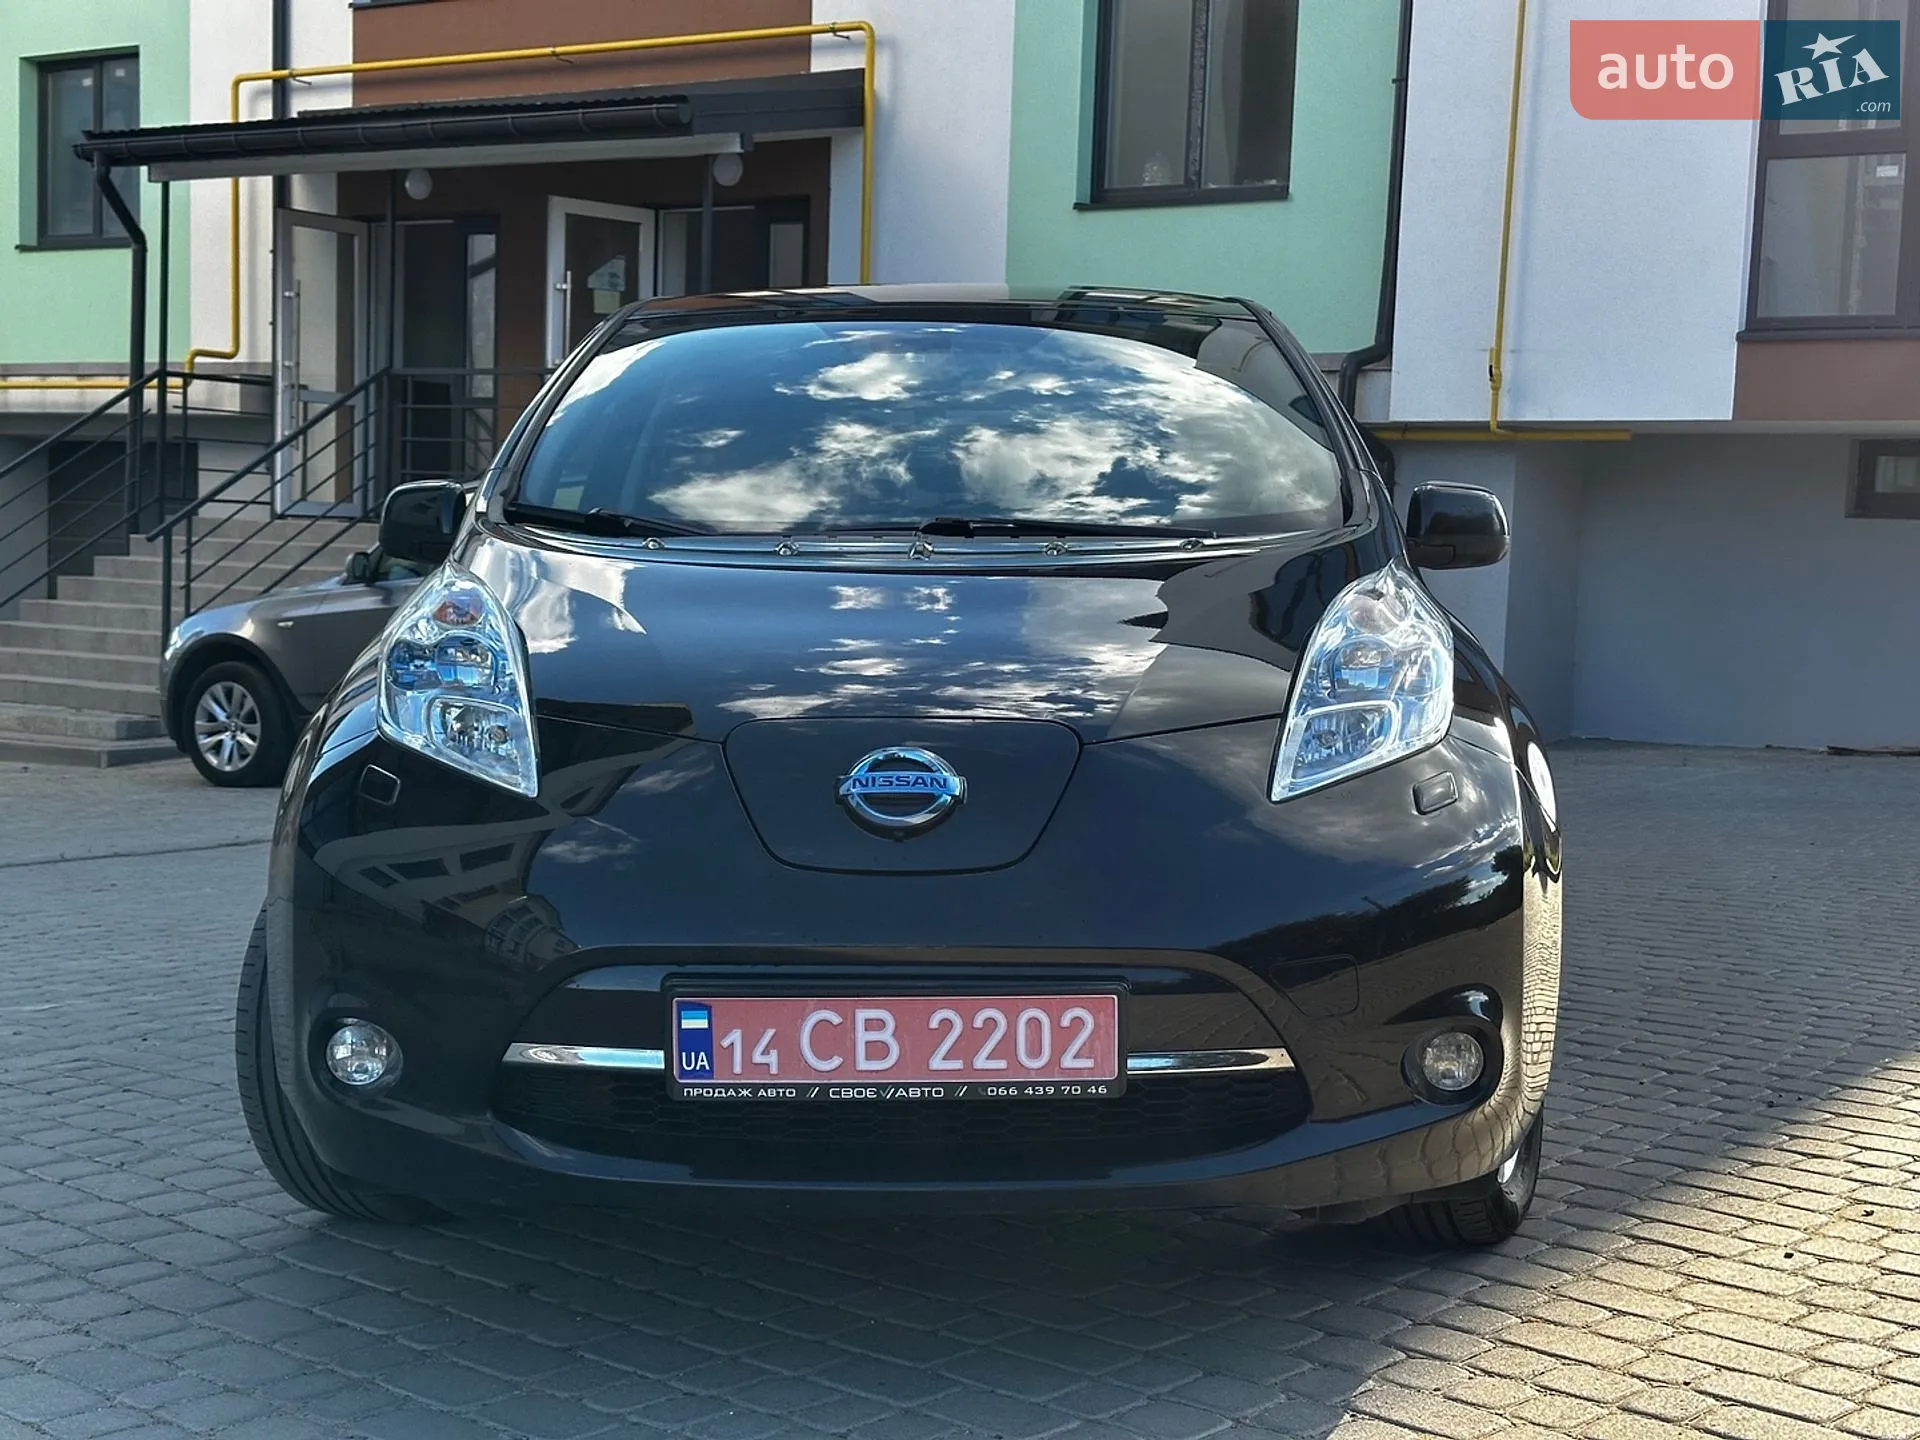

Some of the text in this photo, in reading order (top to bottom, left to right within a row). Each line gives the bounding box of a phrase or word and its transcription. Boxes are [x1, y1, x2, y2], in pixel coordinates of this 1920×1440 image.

[852, 775, 948, 789] NISSAN
[719, 1028, 780, 1075] 14
[927, 1006, 1096, 1071] 2202
[681, 1051, 710, 1071] UA
[683, 1087, 753, 1098] ПРОДАЖ
[757, 1087, 797, 1097] АВТО
[987, 1085, 1018, 1096] 066
[1023, 1085, 1055, 1096] 439
[1061, 1085, 1081, 1095] 70
[1087, 1084, 1108, 1095] 46
